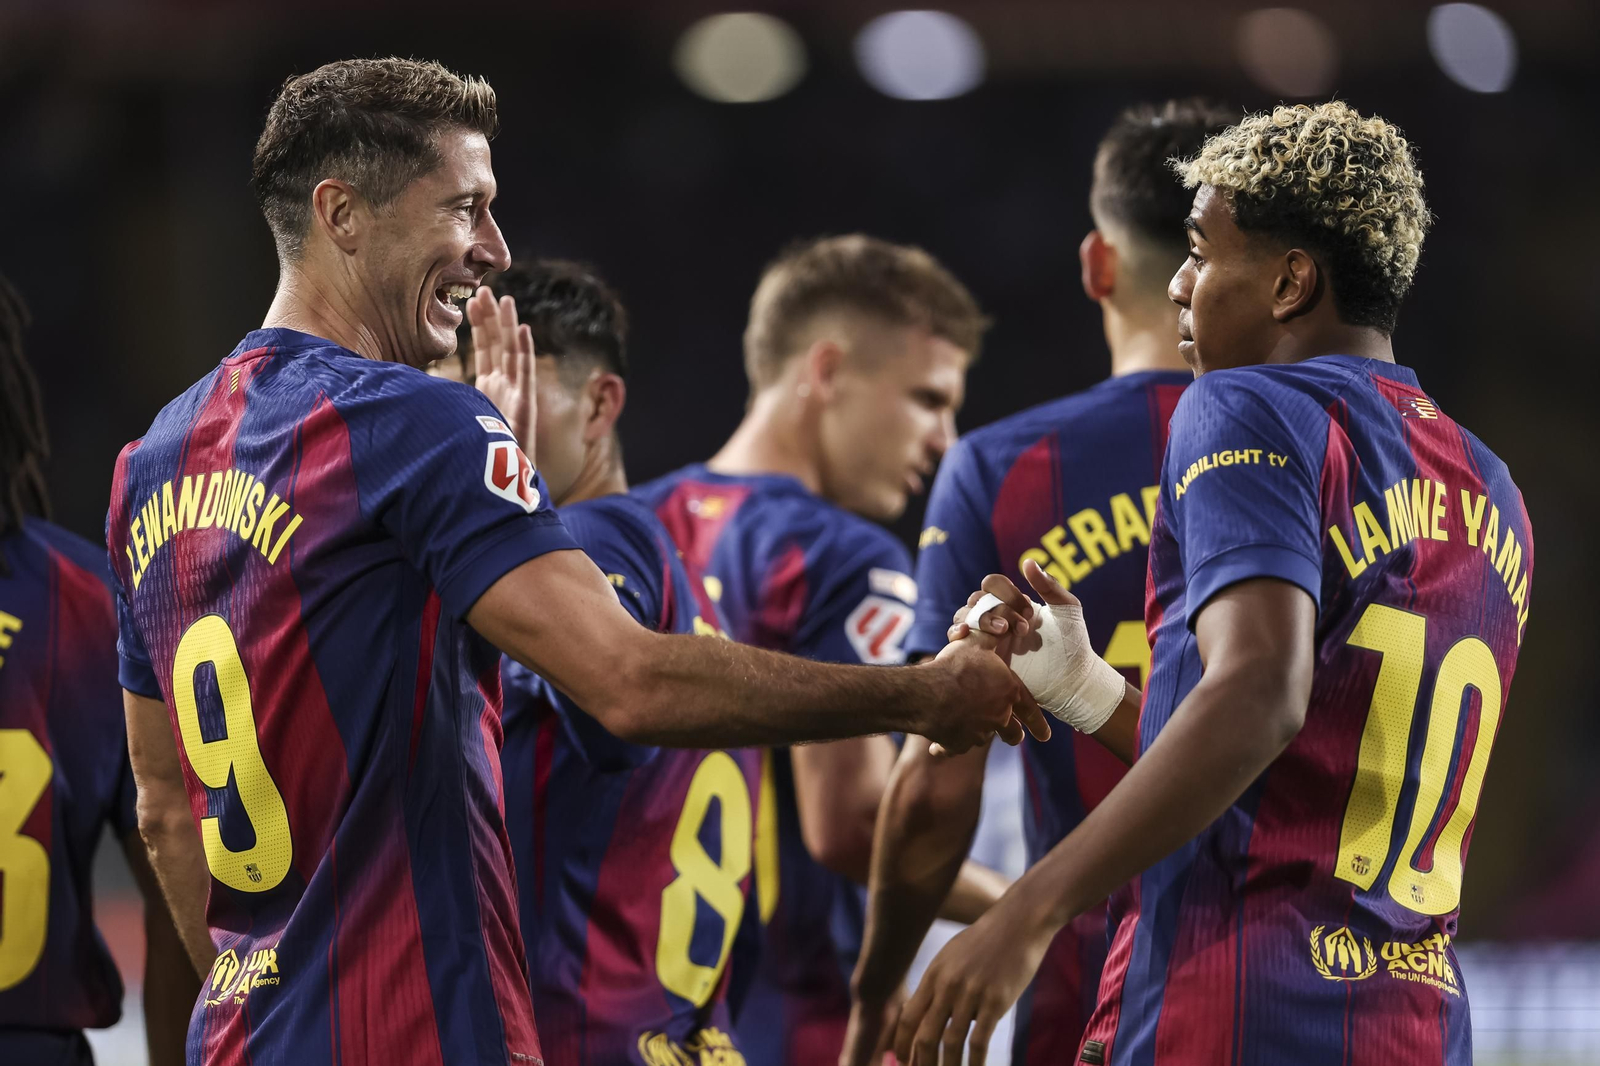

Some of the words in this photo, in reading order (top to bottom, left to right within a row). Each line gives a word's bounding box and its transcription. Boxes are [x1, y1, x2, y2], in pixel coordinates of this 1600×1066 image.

[126, 469, 304, 591] LEWANDOWSKI
[1175, 449, 1263, 501] AMBILIGHT
[1267, 452, 1288, 468] tv
[1328, 477, 1449, 580] LAMINE
[173, 613, 293, 893] 9
[1333, 602, 1503, 916] 10
[656, 750, 753, 1009] 8
[254, 976, 280, 989] gency
[1389, 970, 1408, 980] The
[1408, 972, 1420, 983] UN
